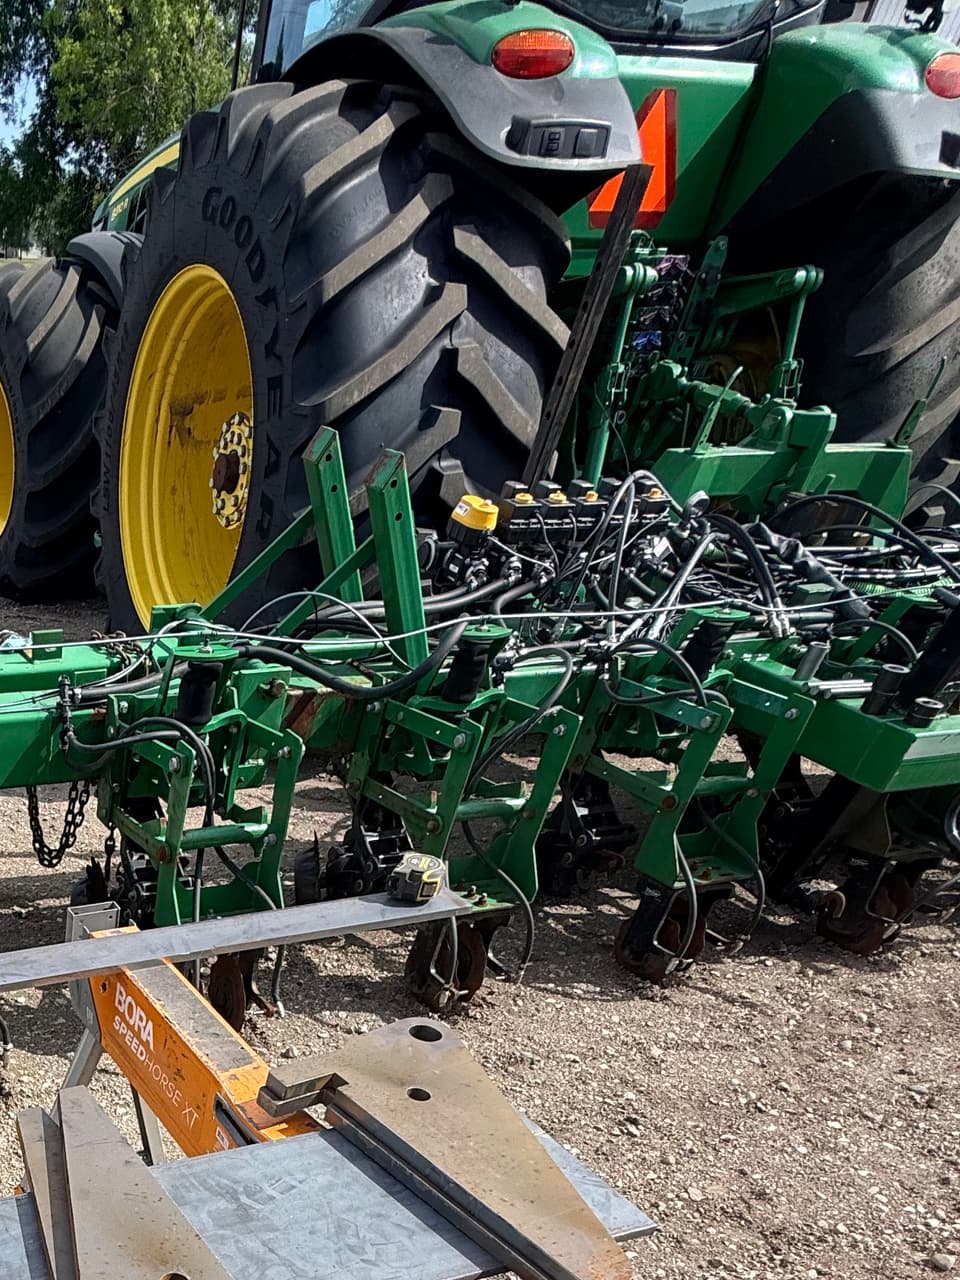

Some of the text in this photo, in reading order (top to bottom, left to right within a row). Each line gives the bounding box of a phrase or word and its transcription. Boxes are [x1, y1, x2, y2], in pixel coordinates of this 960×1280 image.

[201, 186, 283, 540] GOODYEAR
[113, 1015, 200, 1128] SPEEDHORSE XT
[114, 983, 155, 1051] BORA
